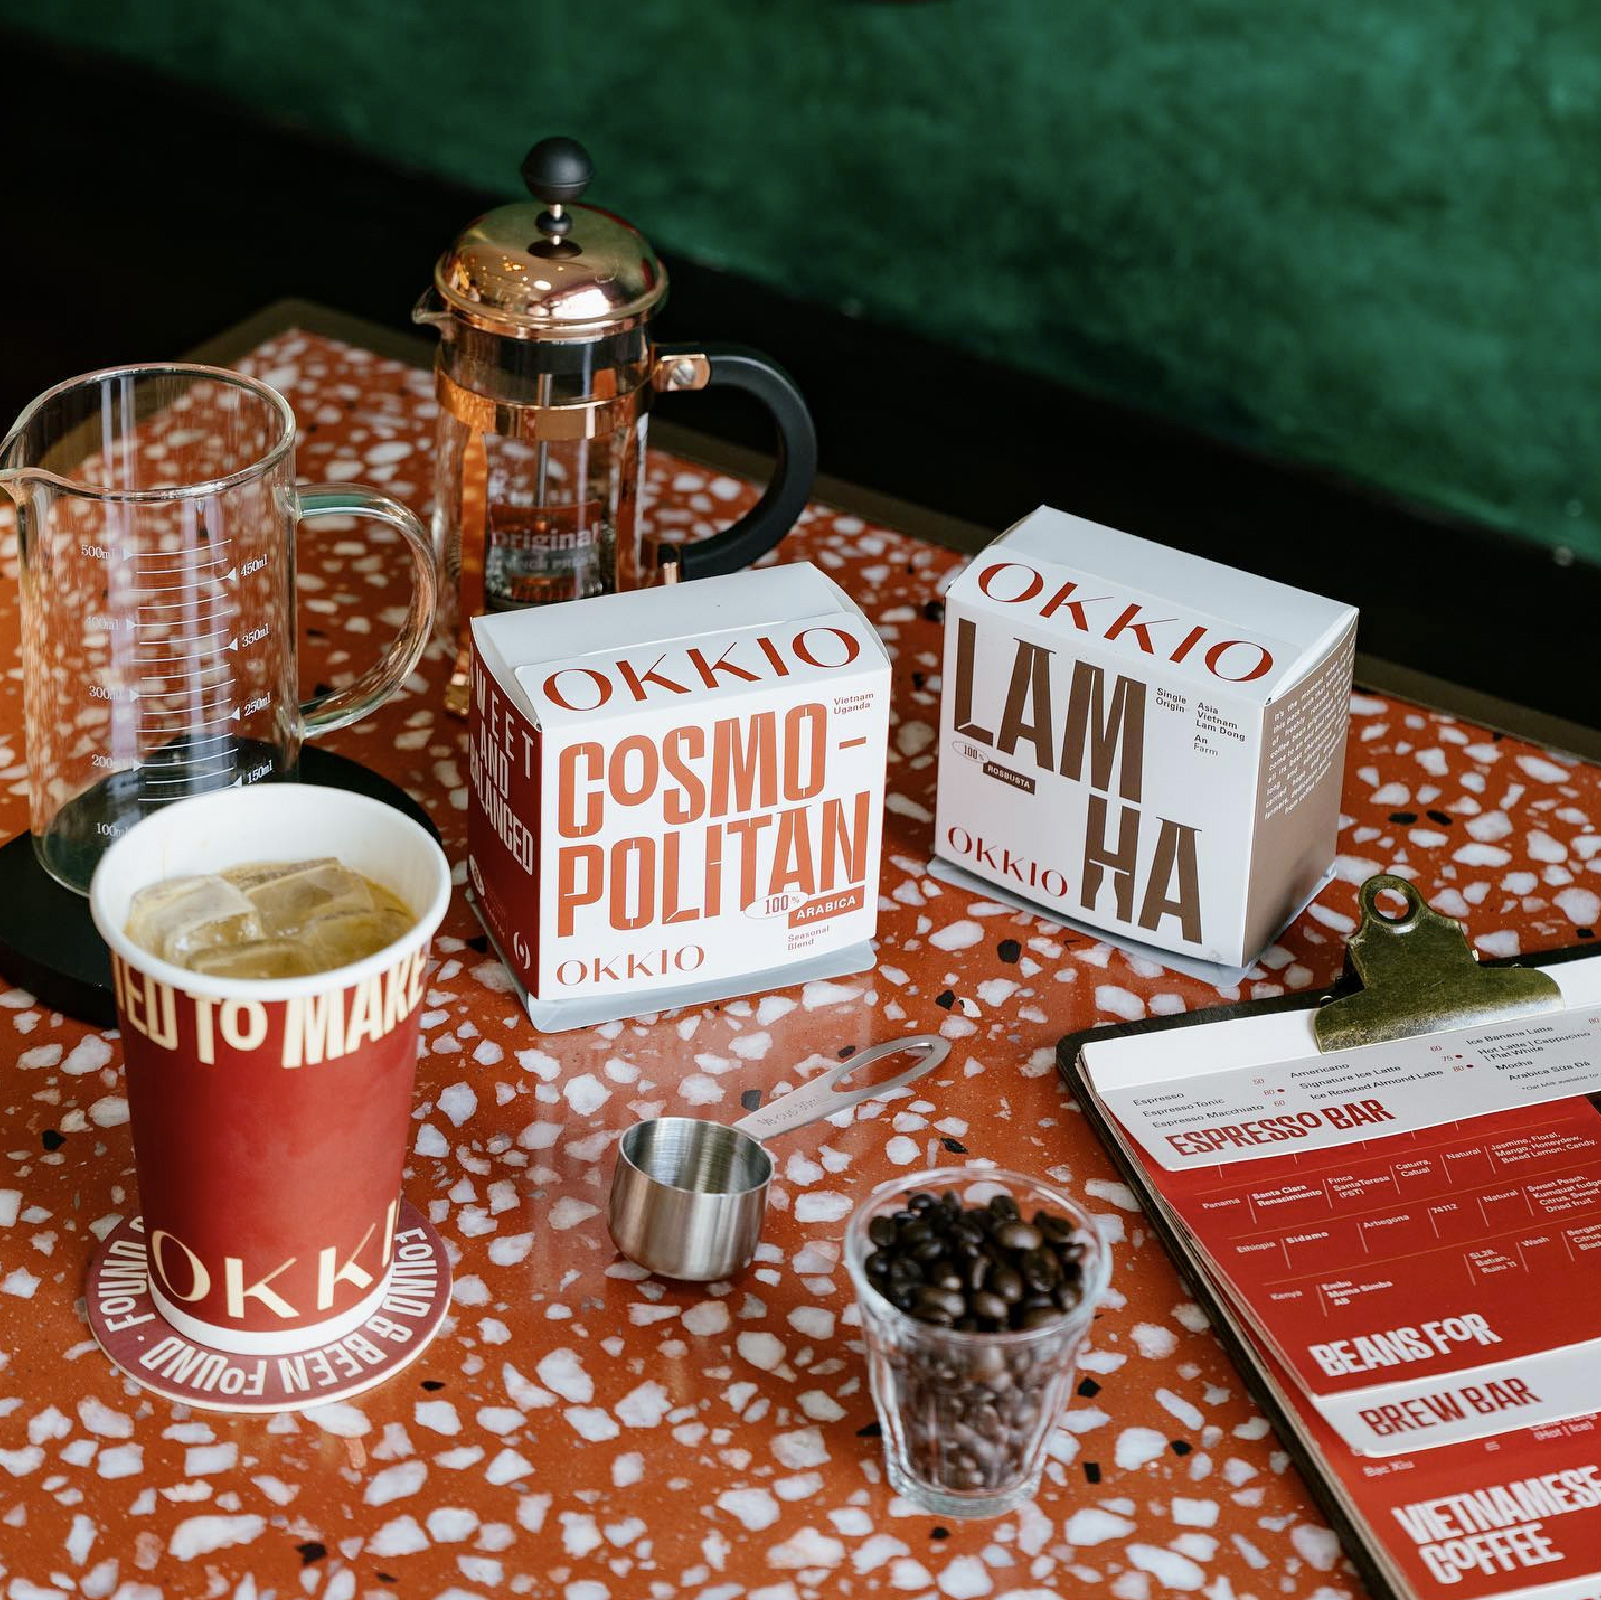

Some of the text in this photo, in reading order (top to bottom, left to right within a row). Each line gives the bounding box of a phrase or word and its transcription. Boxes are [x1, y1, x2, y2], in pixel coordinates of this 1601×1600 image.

[241, 554, 268, 578] 450ml
[978, 562, 1274, 683] OKKIO
[241, 623, 270, 648] 350ml
[542, 627, 861, 711] OKKIO
[243, 692, 271, 717] 250ml
[833, 691, 874, 706] Vietnam
[833, 701, 871, 715] Uganda
[1156, 696, 1185, 713] Origin
[1157, 687, 1187, 704] Single
[954, 617, 1147, 804] LAM
[1197, 711, 1238, 729] Vietnam
[1198, 702, 1218, 715] Asia
[1194, 734, 1208, 744] An
[1196, 720, 1246, 742] Lam Dong
[481, 720, 508, 799] AND
[1194, 742, 1218, 756] Farm
[247, 760, 273, 786] 150ml
[557, 790, 871, 938] POLITAN
[948, 826, 1068, 897] OKKIO
[1080, 793, 1203, 944] HA
[796, 894, 856, 920] ARABICA
[787, 925, 830, 943] Seasonal
[787, 938, 815, 951] Blend
[556, 945, 705, 987] OKKIO
[184, 990, 267, 1065] TO
[281, 949, 427, 1069] MAKE
[1290, 1063, 1349, 1079] Americano
[1299, 1065, 1402, 1089] Signature Ice Latte
[1495, 1060, 1533, 1071] Mocha
[1310, 1069, 1444, 1100] Ice Roasted Almond Latte
[1133, 1092, 1184, 1107] Espresso
[1142, 1104, 1196, 1118] Espresso
[1196, 1098, 1224, 1109] Tonic
[1152, 1114, 1204, 1129] Espresso
[1206, 1104, 1265, 1119] Macchiato
[1165, 1099, 1397, 1156] ESPRESSO BAR
[1446, 1148, 1482, 1161] Natural
[1483, 1190, 1519, 1203] Natural
[152, 1199, 400, 1319] OKKI
[382, 1227, 437, 1317] FOUND
[98, 1240, 156, 1332] FOUND
[1308, 1313, 1503, 1376] BEANS FOR
[139, 1336, 267, 1395] FOUND
[277, 1333, 388, 1394] BEEN
[1358, 1378, 1542, 1438] BREW BAR
[1418, 1522, 1566, 1584] COFFEE
